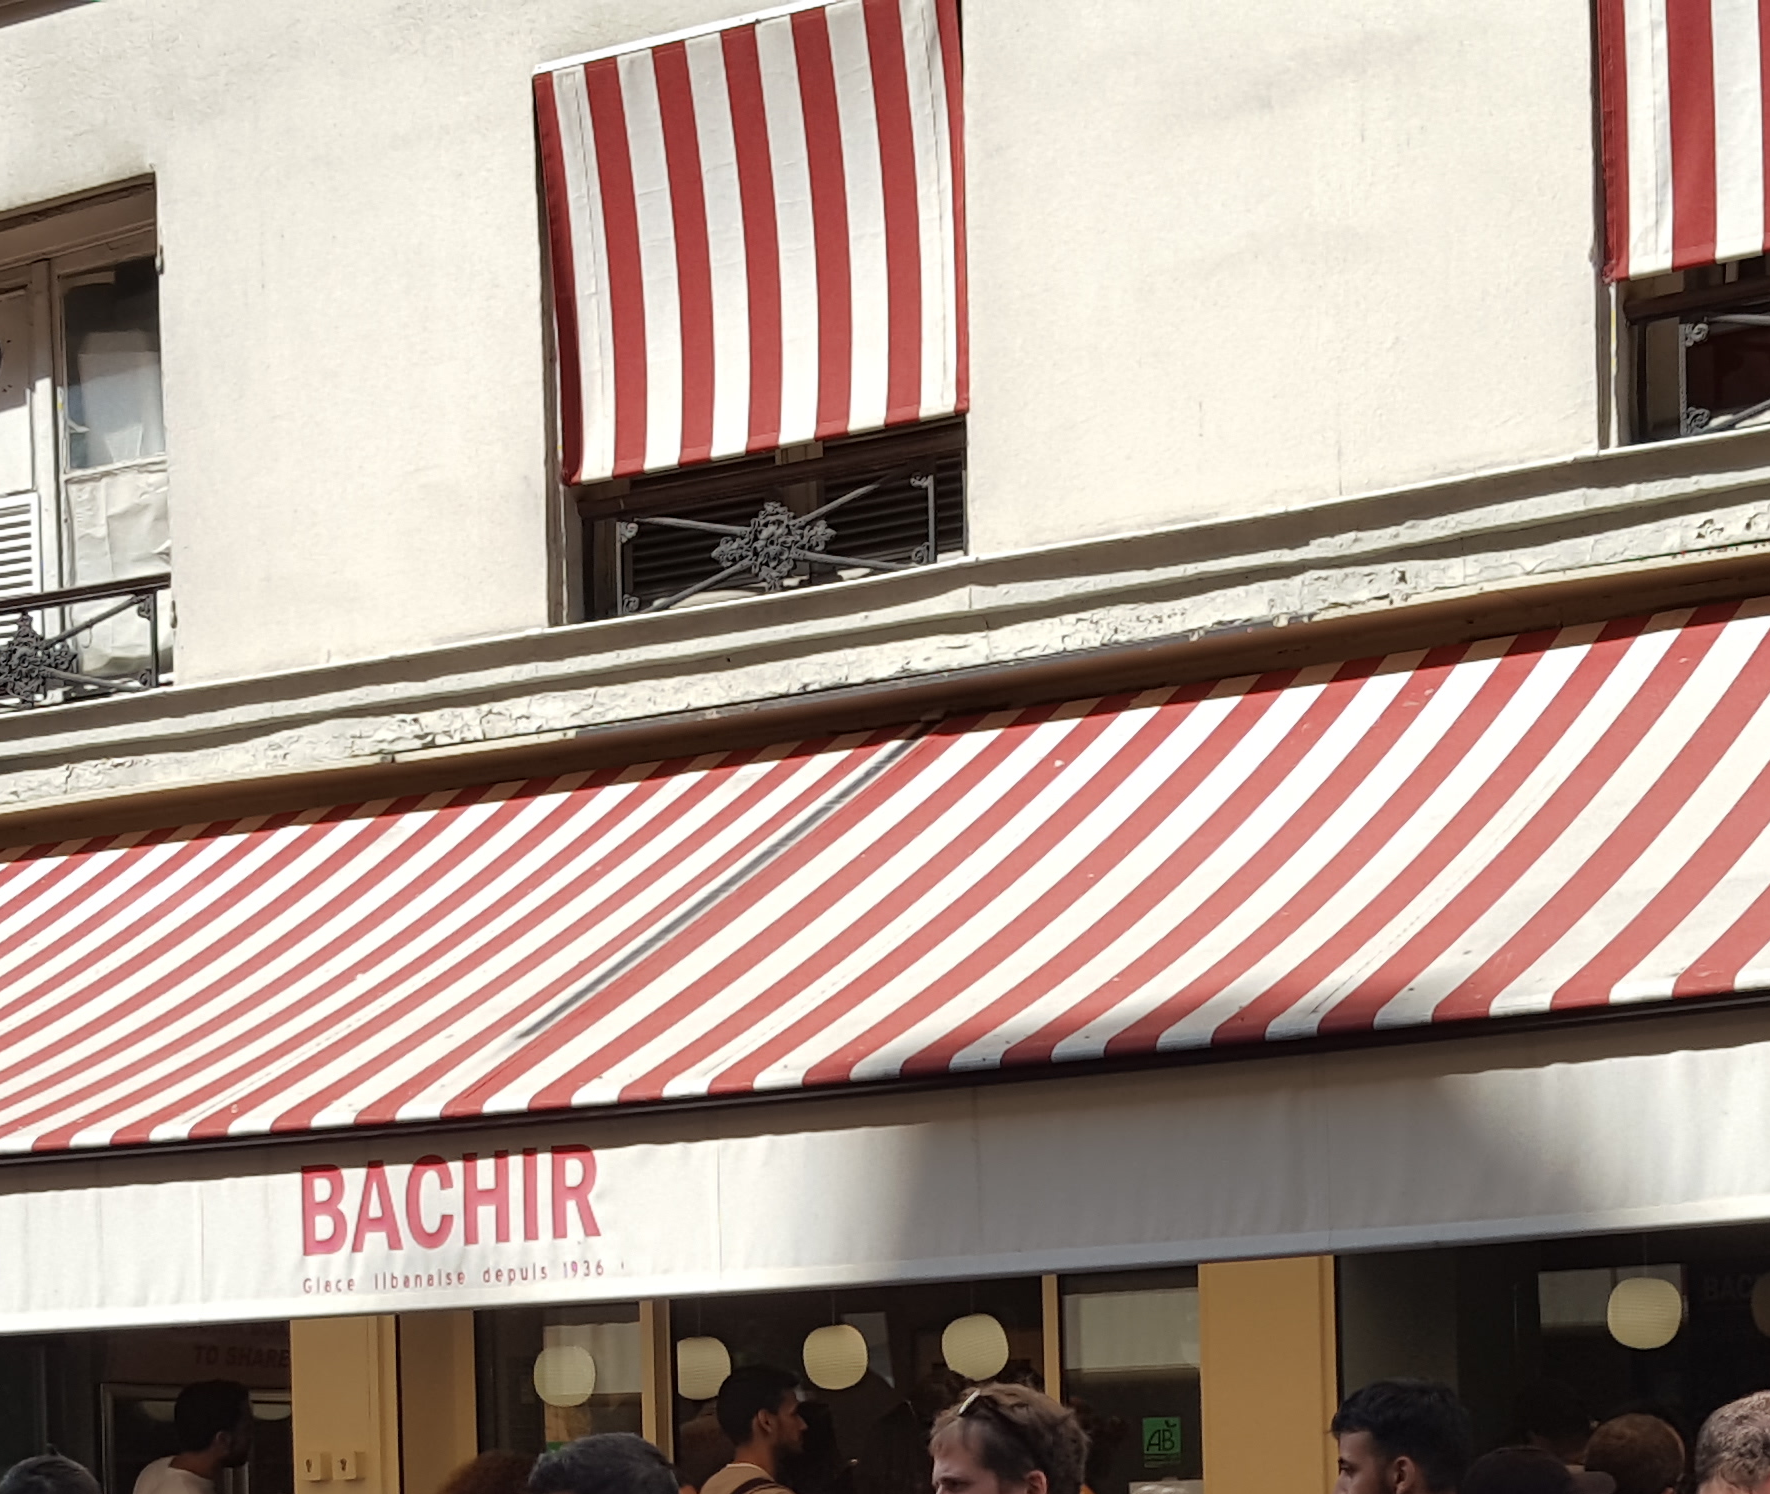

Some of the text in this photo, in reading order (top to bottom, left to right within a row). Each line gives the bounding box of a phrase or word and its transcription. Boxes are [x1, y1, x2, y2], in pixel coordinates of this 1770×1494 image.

[301, 1143, 602, 1257] BACHIR
[302, 1259, 605, 1294] Glace libanaise depuis 1936
[1146, 1428, 1175, 1451] AB
